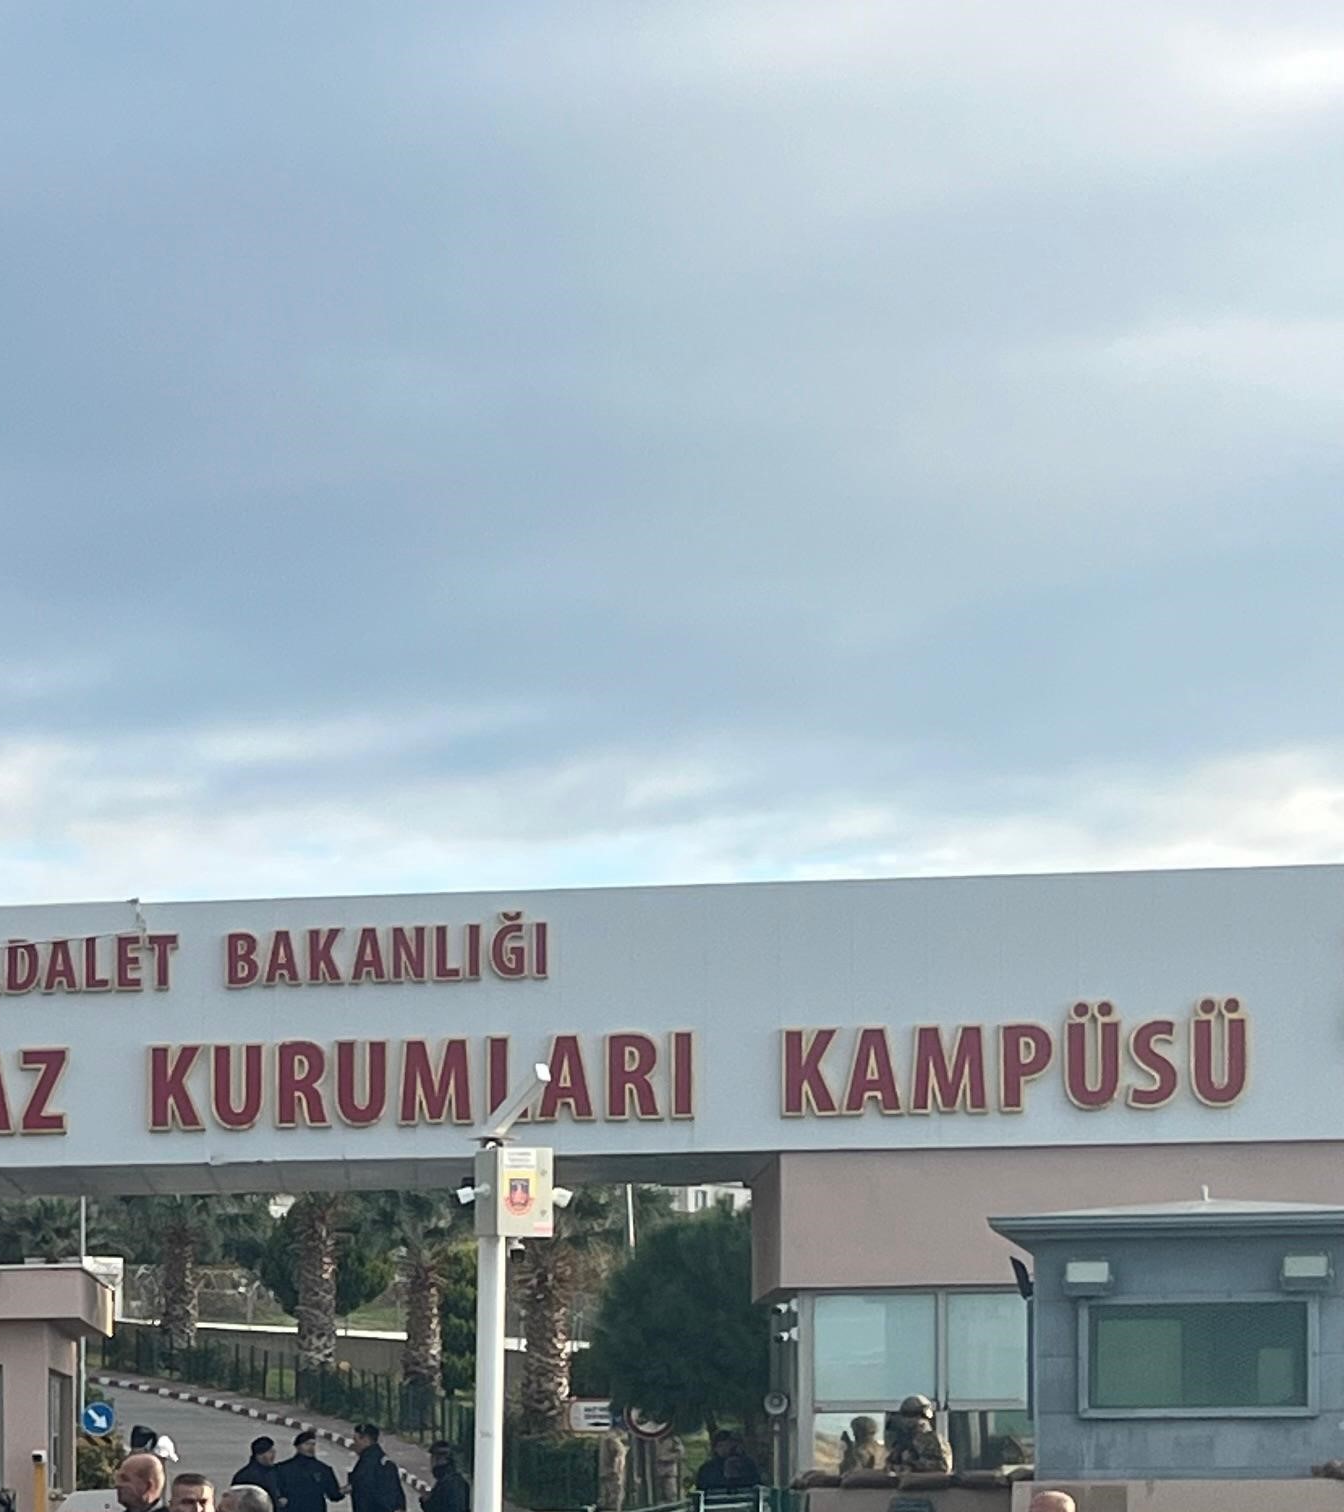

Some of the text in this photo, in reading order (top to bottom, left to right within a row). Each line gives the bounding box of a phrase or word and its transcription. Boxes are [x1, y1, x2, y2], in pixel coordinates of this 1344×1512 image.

[224, 910, 549, 989] BAKANLIĞI
[148, 1030, 696, 1131] KURUMLARI
[780, 997, 1249, 1118] KAMPÜSÜ
